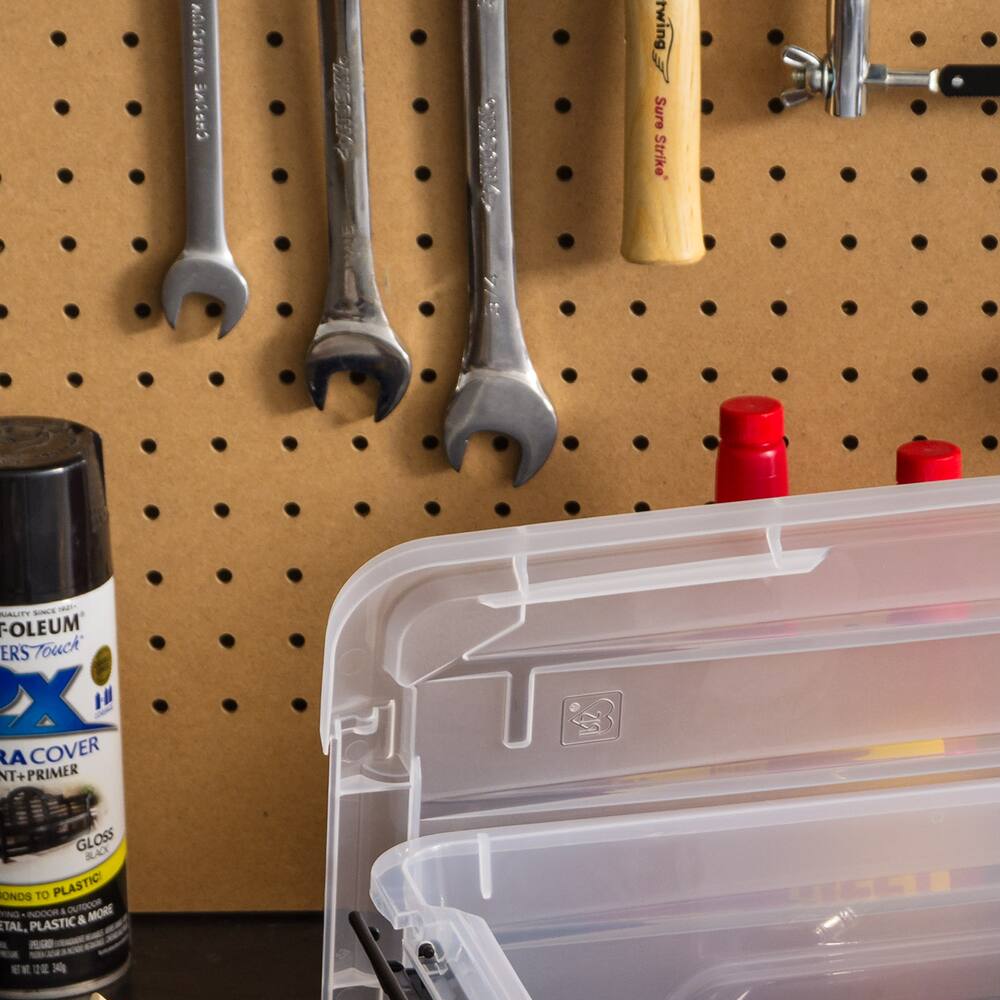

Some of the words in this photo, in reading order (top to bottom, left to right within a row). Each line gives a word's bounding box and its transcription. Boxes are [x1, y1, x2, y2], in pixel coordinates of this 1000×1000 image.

[655, 96, 667, 129] Sure
[655, 135, 668, 180] Strike
[33, 608, 57, 616] SINCE
[35, 635, 79, 660] Touch
[30, 736, 100, 765] COVER
[76, 828, 114, 852] GLOSS
[85, 846, 109, 861] BLACK
[35, 891, 50, 900] TO
[67, 898, 103, 915] OUTDOOR
[29, 917, 76, 932] PLASTIC
[77, 914, 87, 925] &
[88, 903, 114, 922] MORE
